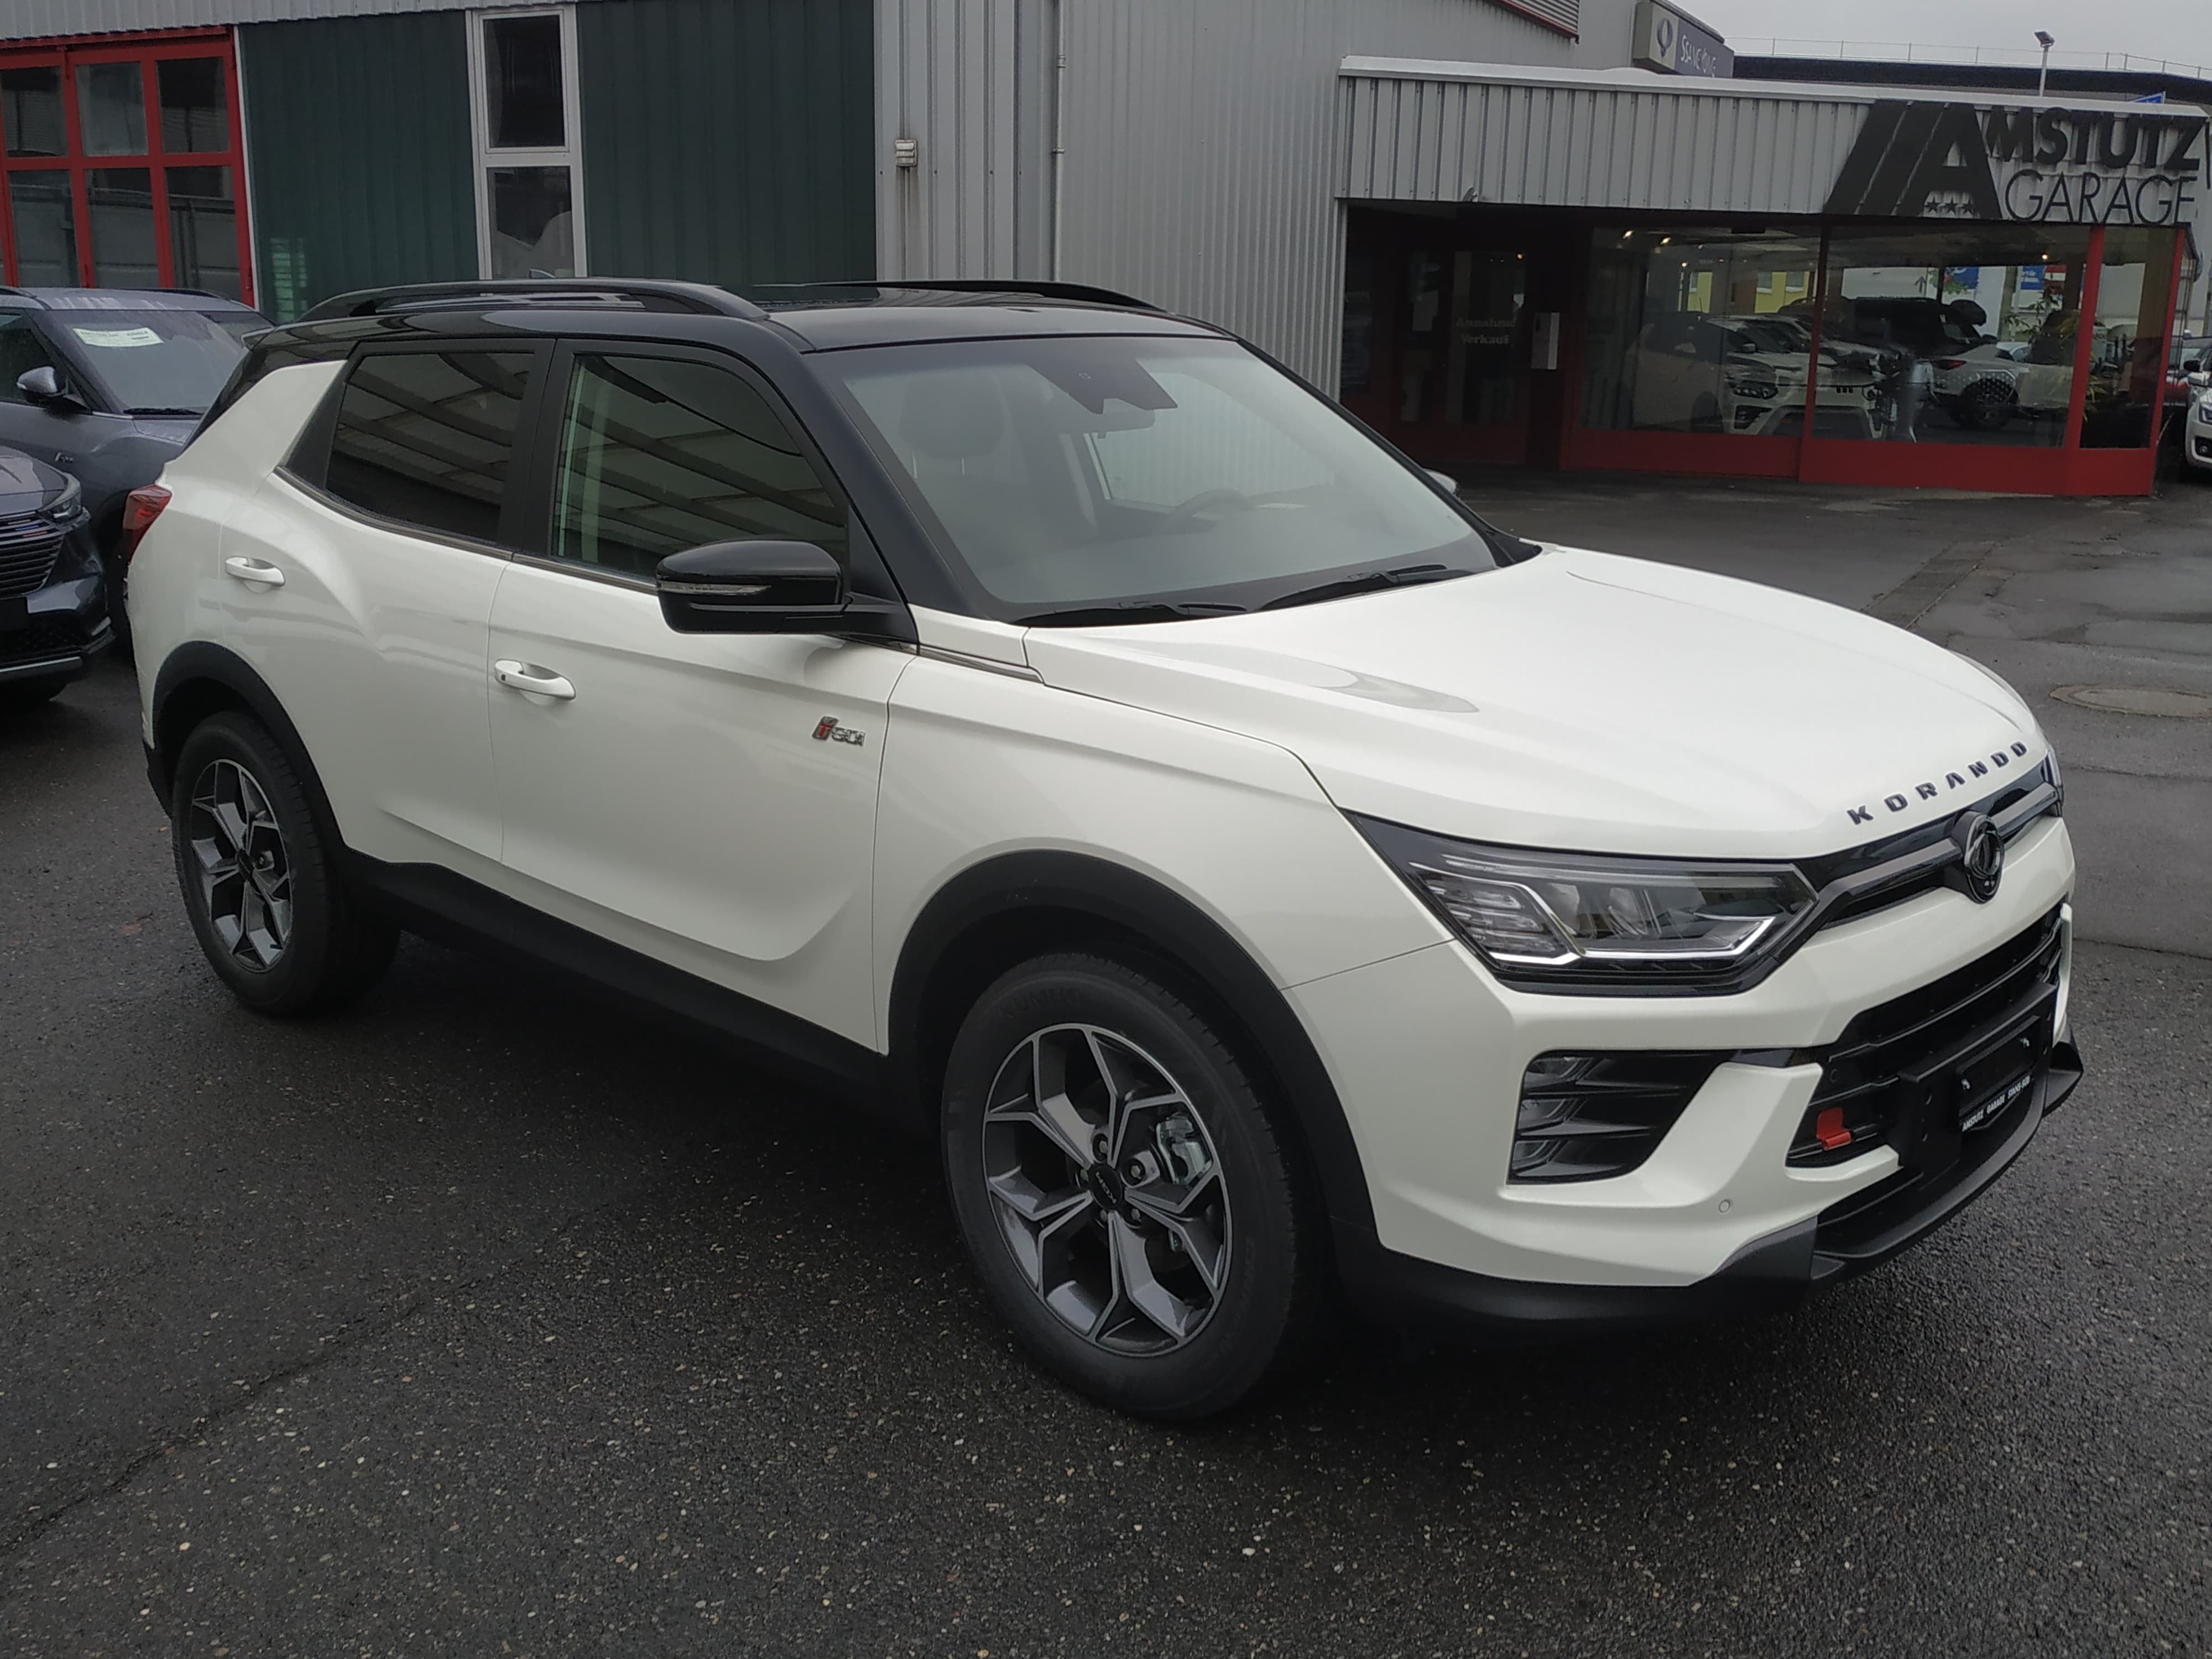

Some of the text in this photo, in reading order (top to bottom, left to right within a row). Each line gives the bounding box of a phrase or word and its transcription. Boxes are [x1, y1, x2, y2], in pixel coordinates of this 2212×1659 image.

[1893, 102, 2206, 220] AMSTUTZ
[2005, 169, 2198, 223] GARAGE
[1460, 333, 1510, 344] Verkauf
[1846, 742, 2028, 825] KORANDO
[1962, 1109, 1984, 1132] AMSTUTZ
